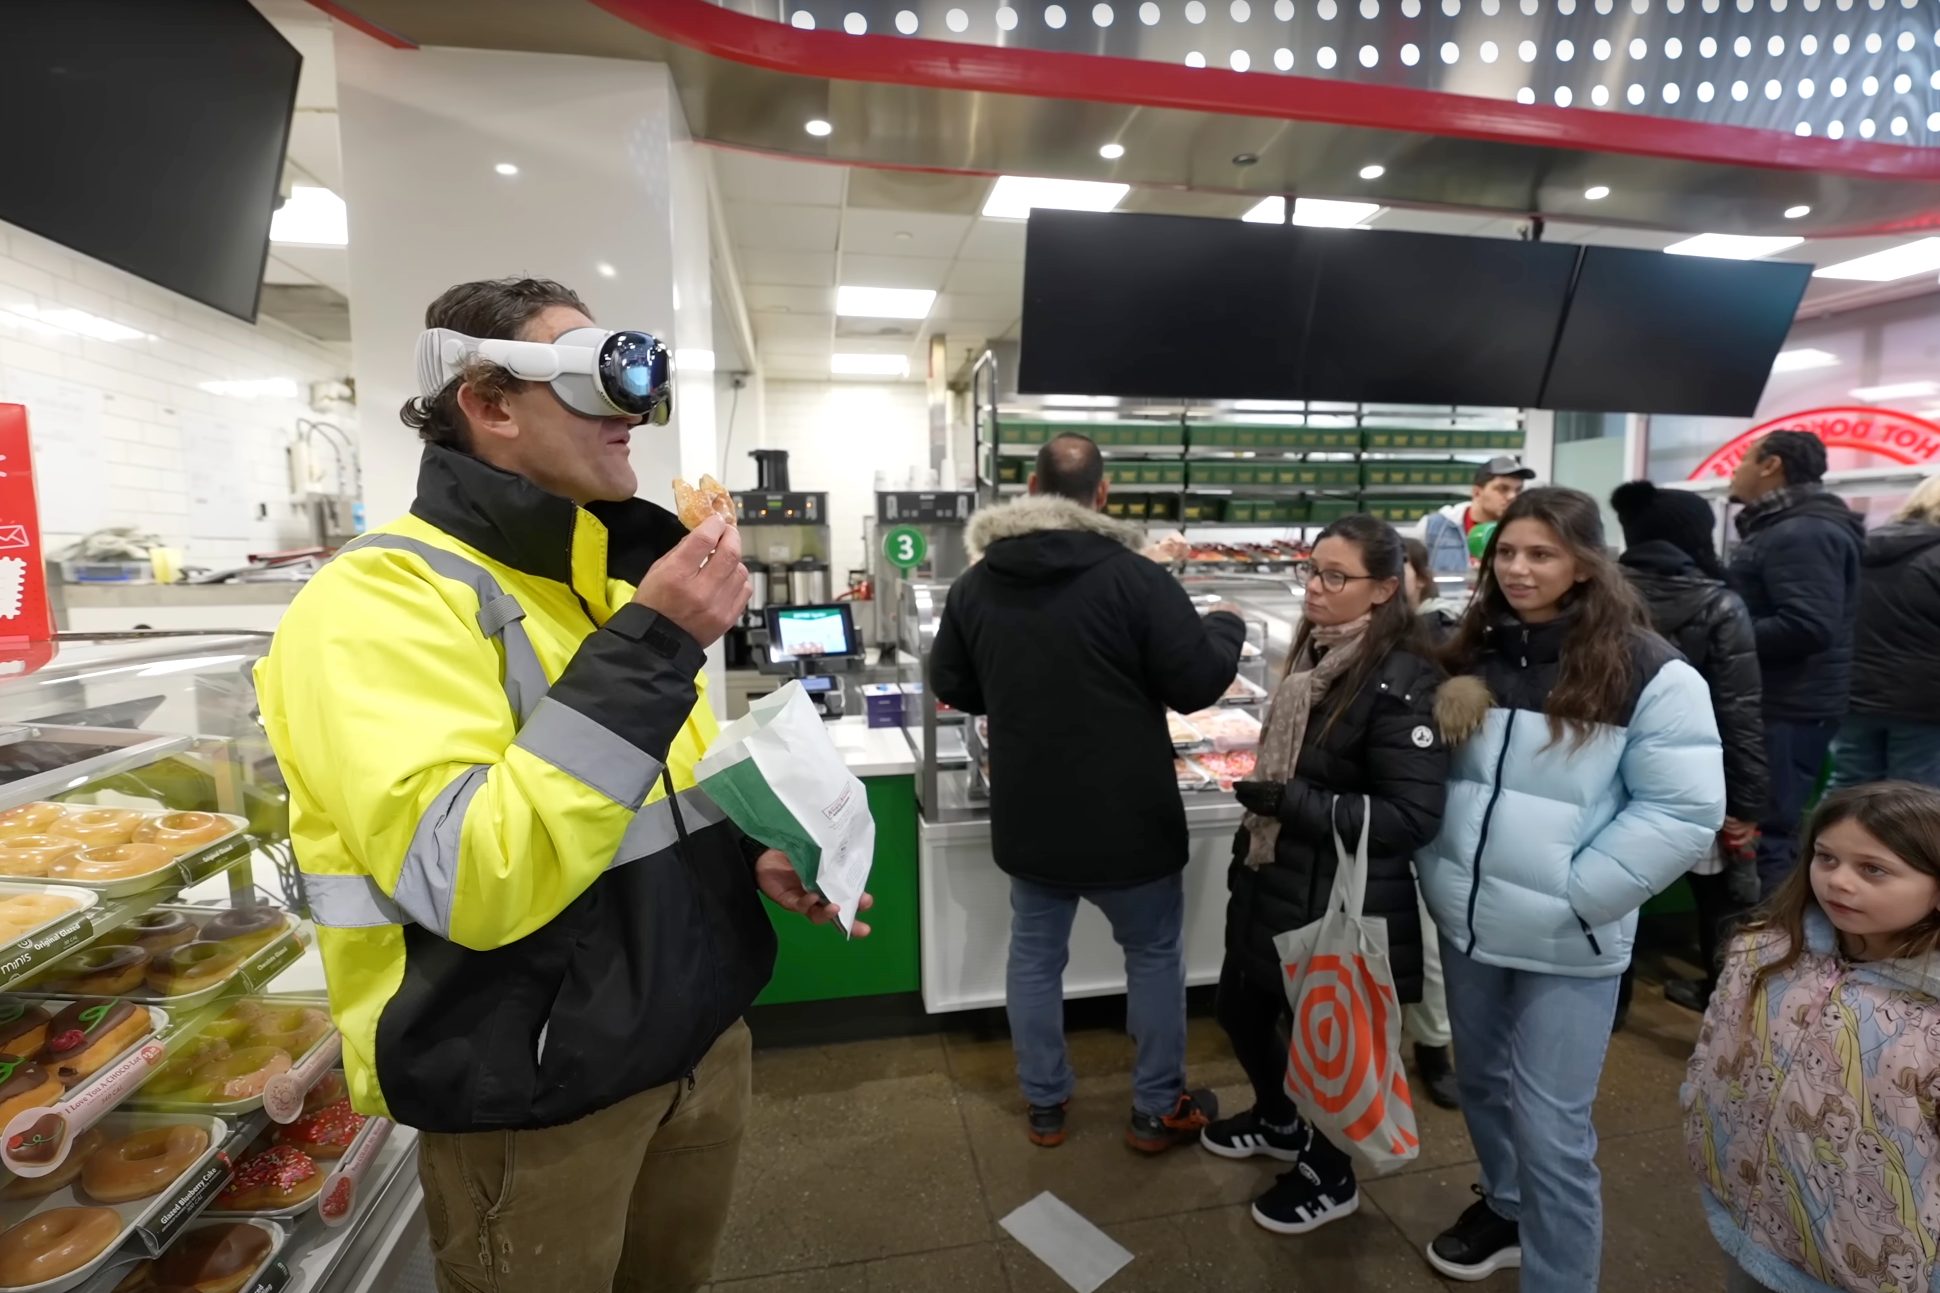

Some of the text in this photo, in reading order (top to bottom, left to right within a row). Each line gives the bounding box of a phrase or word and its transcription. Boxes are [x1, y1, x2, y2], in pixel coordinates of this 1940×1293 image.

[897, 534, 914, 561] 3
[34, 922, 81, 951] Original Glazed
[0, 953, 32, 975] minis
[70, 1096, 88, 1111] Love
[87, 1086, 102, 1099] You
[160, 1168, 217, 1225] Glazed Blueberry Cake
